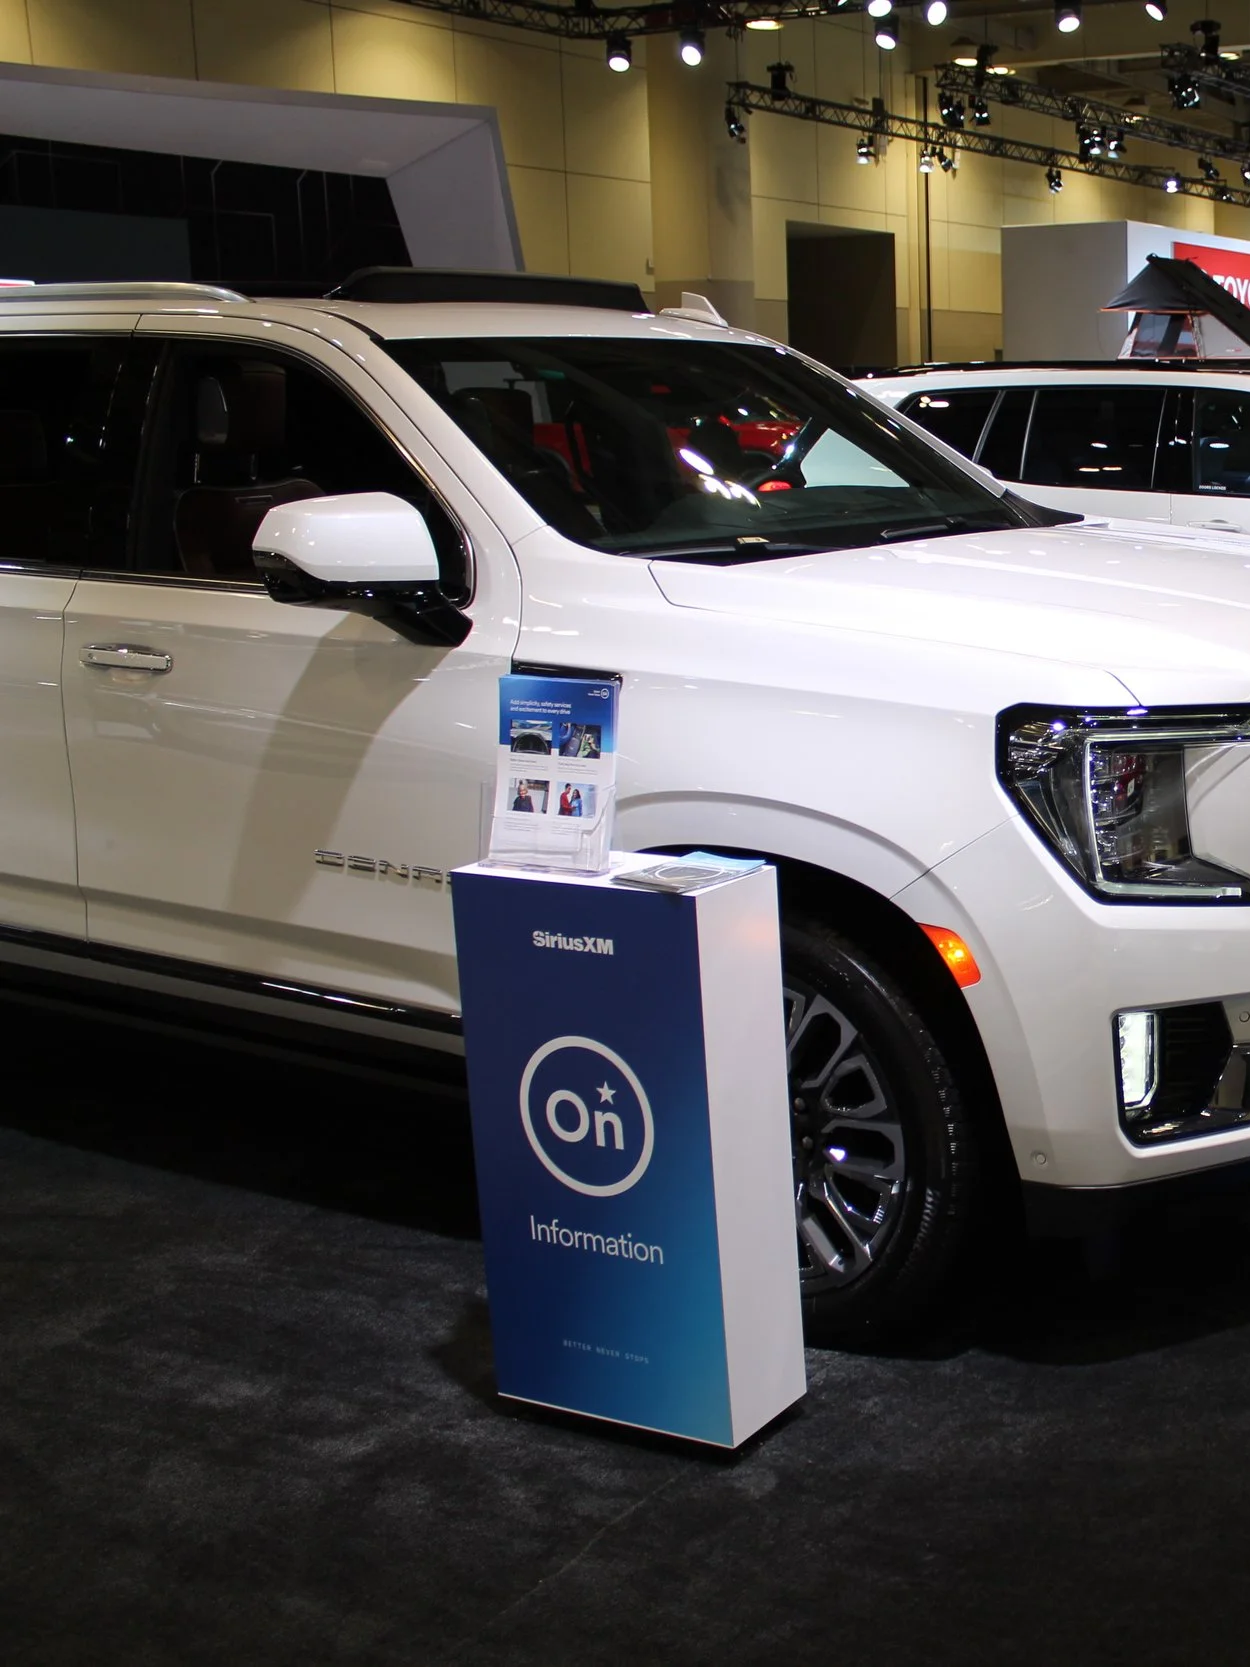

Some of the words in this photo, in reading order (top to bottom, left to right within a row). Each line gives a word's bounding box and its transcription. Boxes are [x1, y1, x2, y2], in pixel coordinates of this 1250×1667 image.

[314, 849, 452, 885] DENA
[532, 930, 614, 955] SiriusXM
[545, 1089, 625, 1150] On
[529, 1215, 664, 1265] Information
[563, 1339, 592, 1351] BETTER
[596, 1346, 620, 1358] NEVER
[625, 1352, 649, 1364] STOPS
